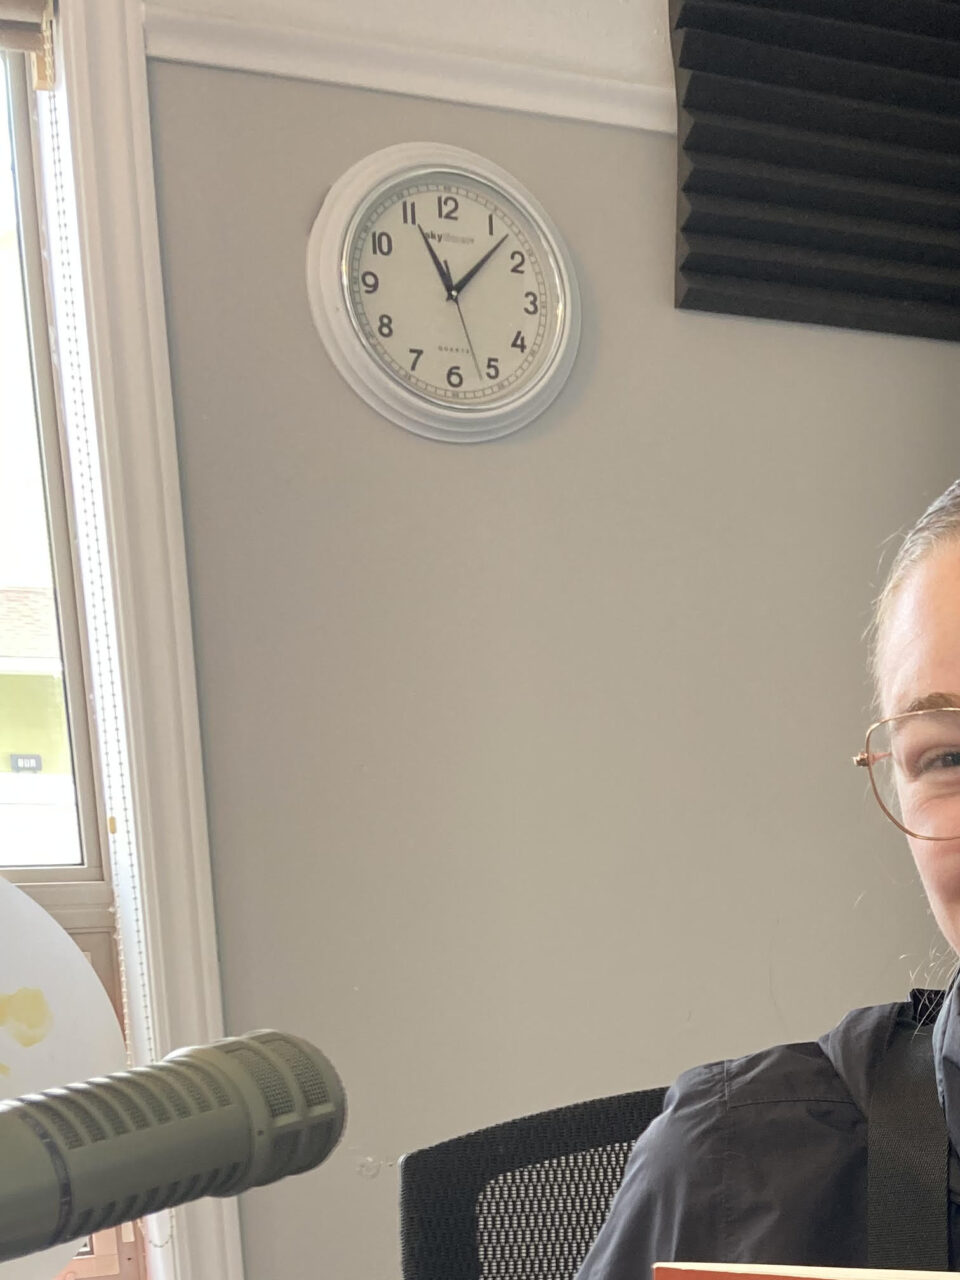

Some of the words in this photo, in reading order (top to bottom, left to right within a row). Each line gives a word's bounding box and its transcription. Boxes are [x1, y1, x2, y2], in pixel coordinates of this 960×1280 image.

[402, 201, 416, 225] 11
[437, 195, 459, 221] 12
[488, 213, 495, 236] 1
[371, 231, 393, 256] 10
[510, 251, 525, 274] 2
[361, 271, 379, 294] 9
[523, 291, 538, 315] 3
[377, 314, 393, 338] 8
[511, 330, 527, 353] 4
[409, 348, 423, 371] 7
[486, 357, 499, 380] 5
[446, 366, 463, 388] 6
